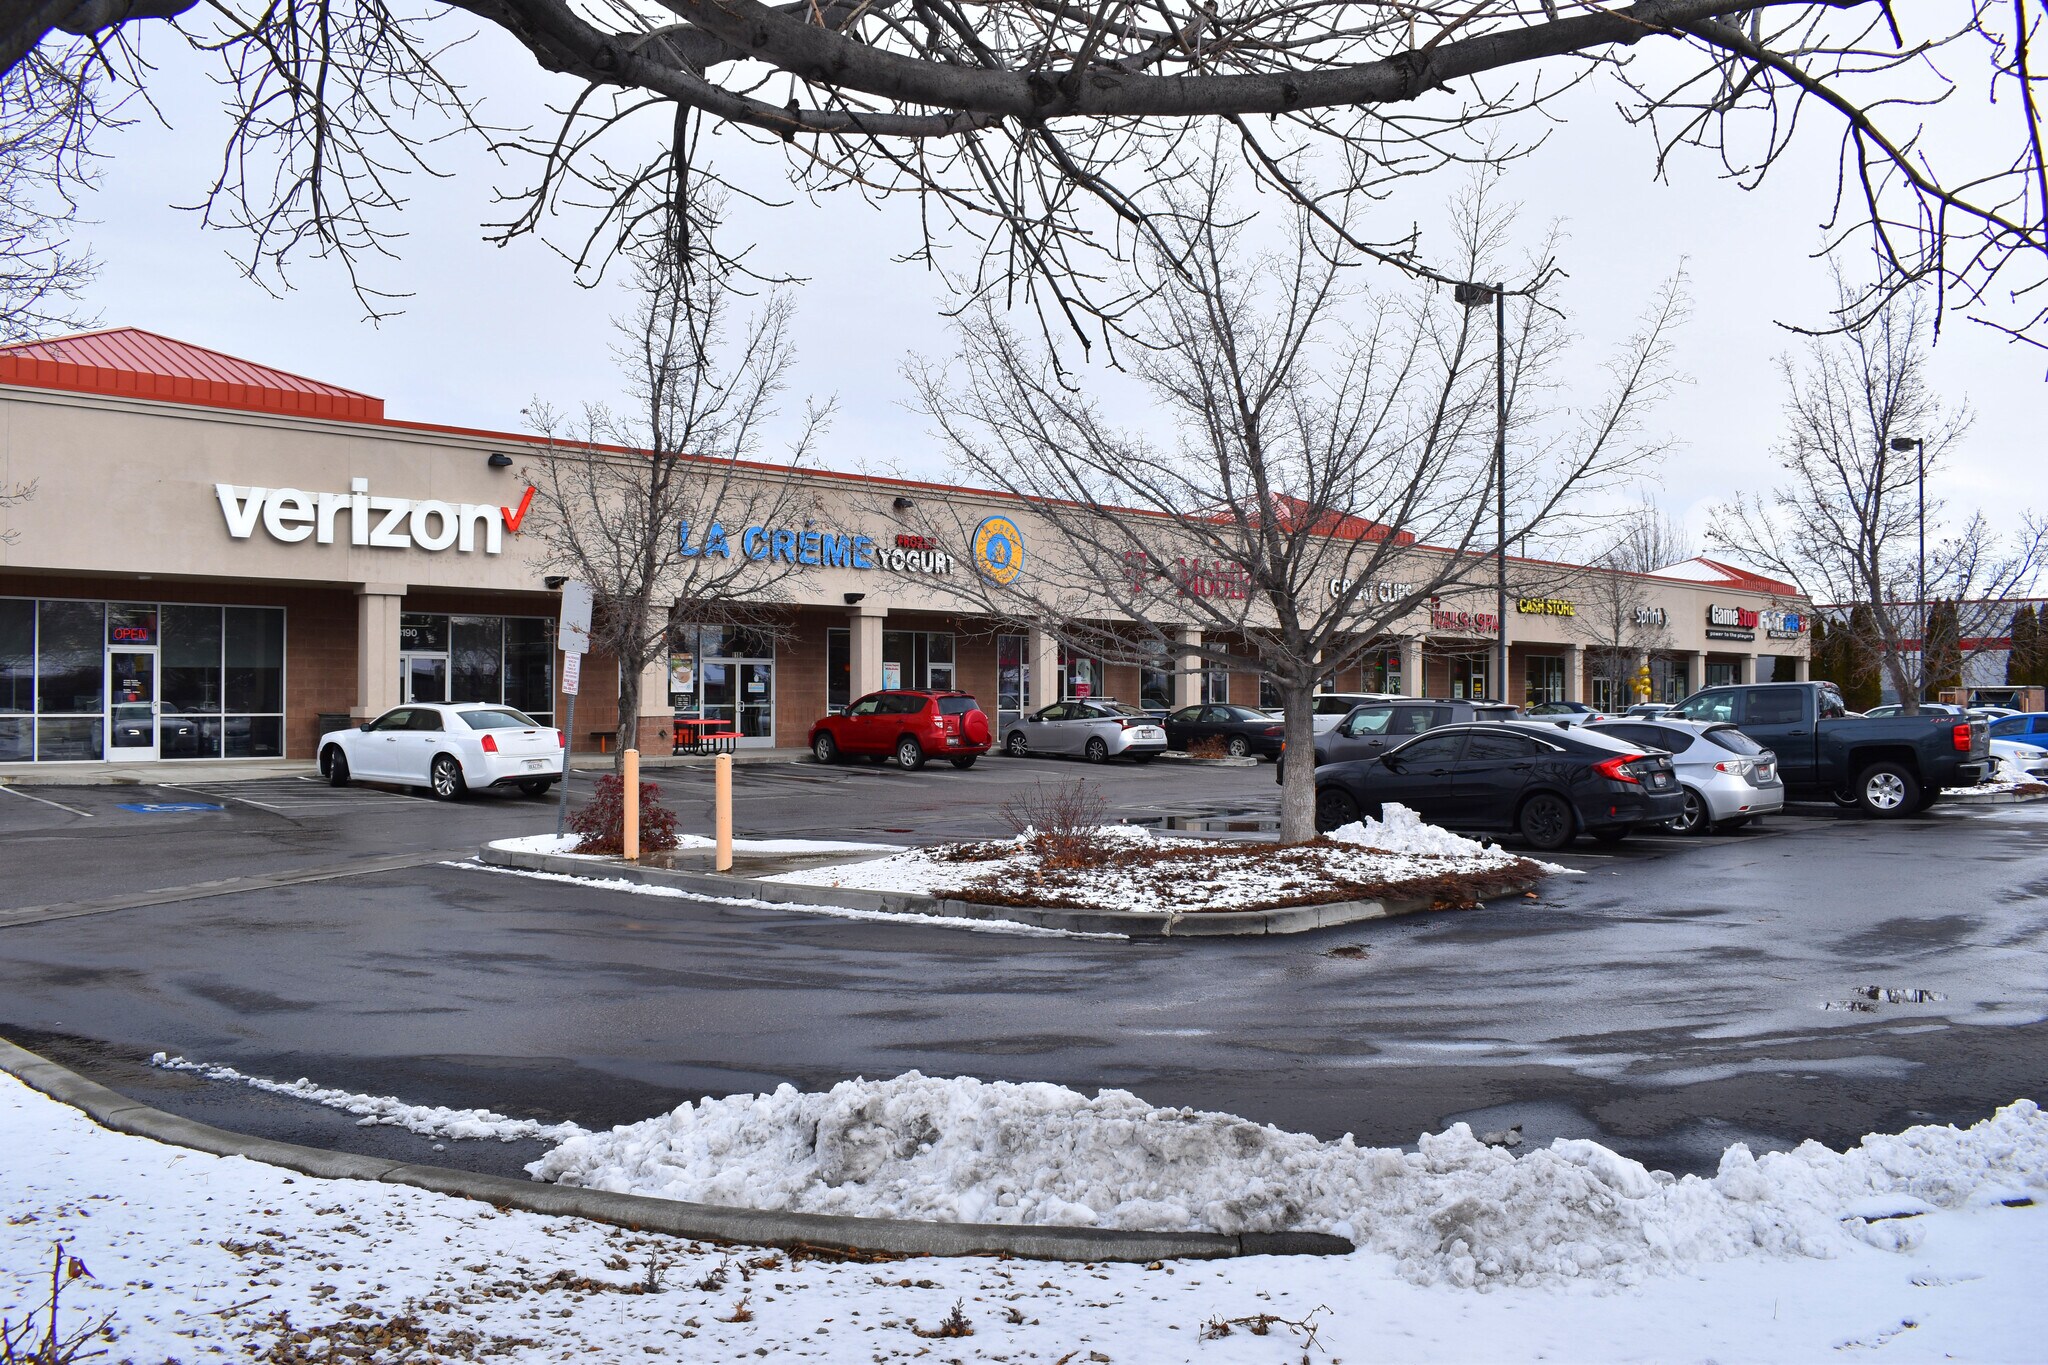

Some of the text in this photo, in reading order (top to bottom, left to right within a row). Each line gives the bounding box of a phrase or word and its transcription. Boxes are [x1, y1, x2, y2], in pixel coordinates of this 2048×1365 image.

[215, 477, 501, 554] verizon
[677, 520, 731, 558] LA
[879, 549, 954, 575] YOGURT
[1330, 578, 1413, 602] GRAT CLIPS
[1519, 598, 1576, 616] CASH STORE
[1636, 606, 1662, 628] Sprint
[1711, 604, 1759, 628] GameStop
[400, 628, 418, 637] 190
[1433, 610, 1469, 632] NAILS
[1477, 612, 1499, 633] SPA
[114, 628, 148, 640] OPEN
